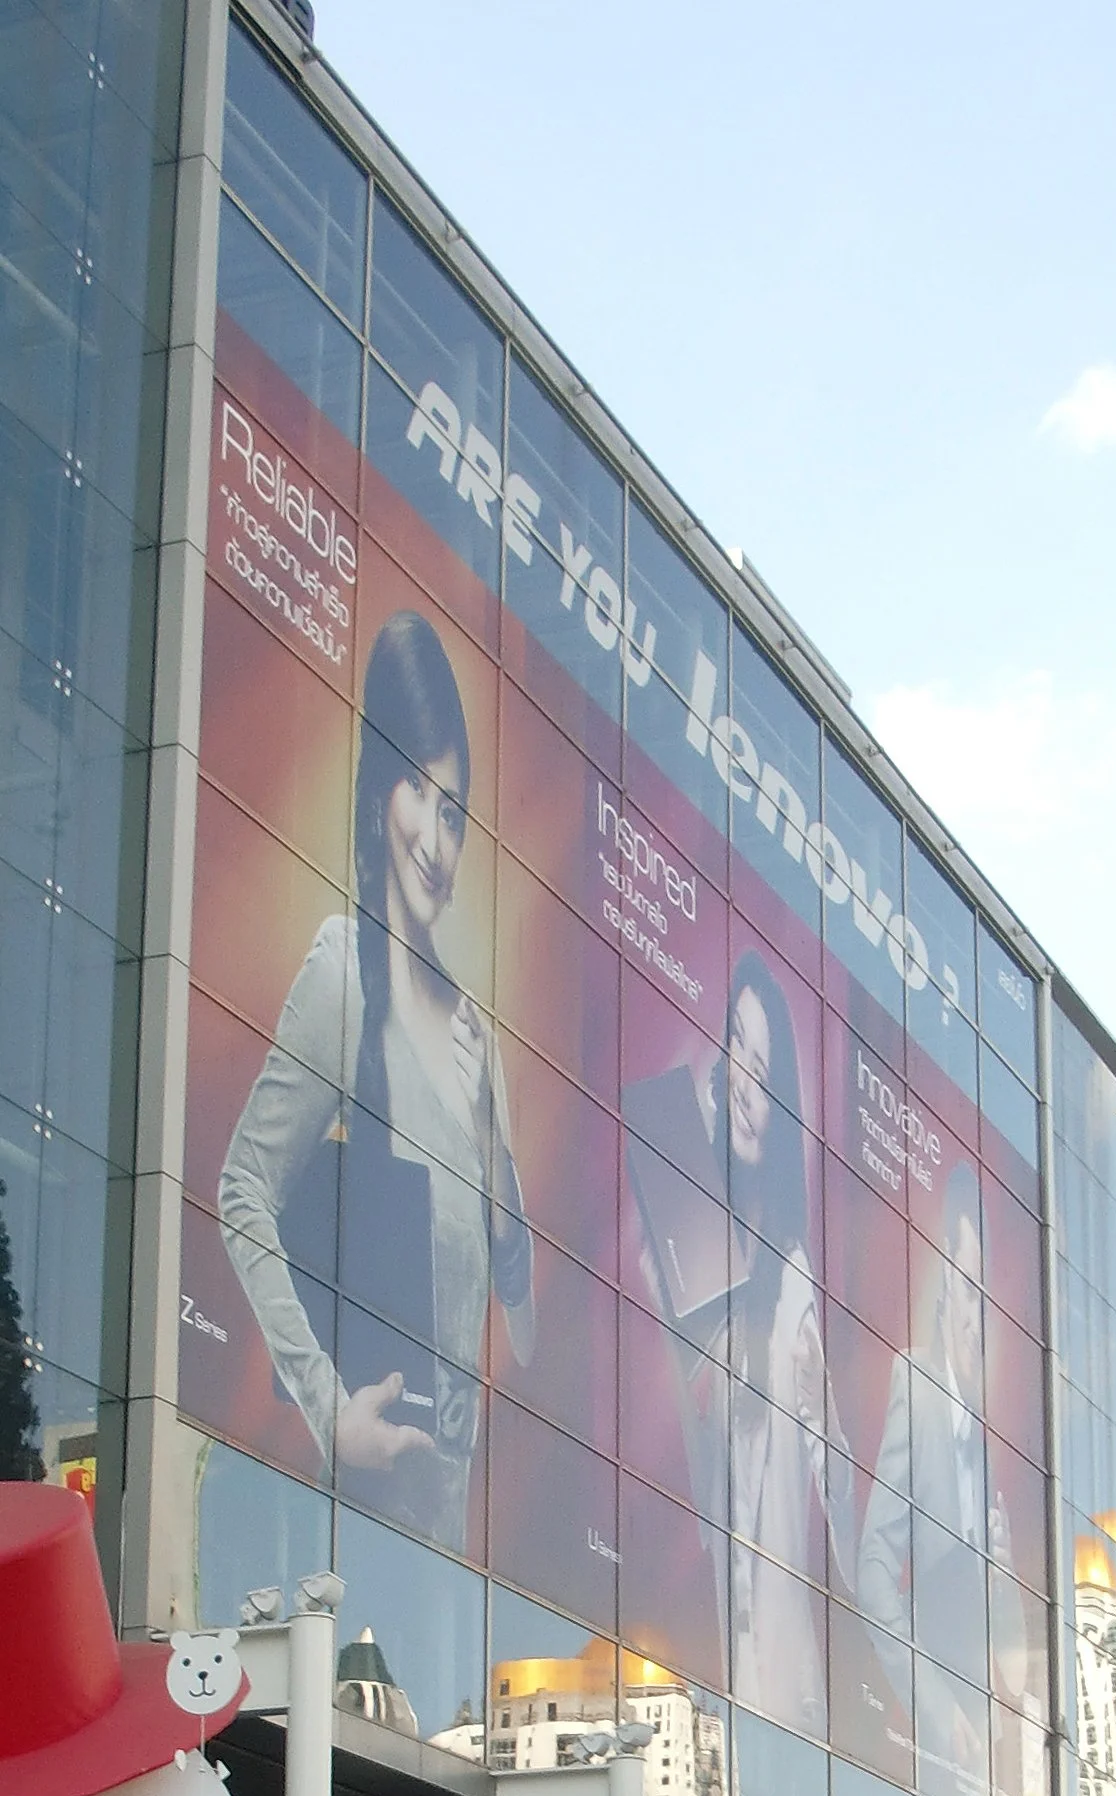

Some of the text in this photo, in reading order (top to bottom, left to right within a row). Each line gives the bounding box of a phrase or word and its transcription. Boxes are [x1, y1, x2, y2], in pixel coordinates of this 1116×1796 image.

[221, 400, 357, 585] Reliable
[407, 382, 541, 567] ARE
[560, 522, 657, 688] YOU
[686, 650, 928, 990] lenovo
[598, 781, 697, 923] Inspired
[857, 1049, 942, 1166] Innovative
[180, 1294, 194, 1325] Z
